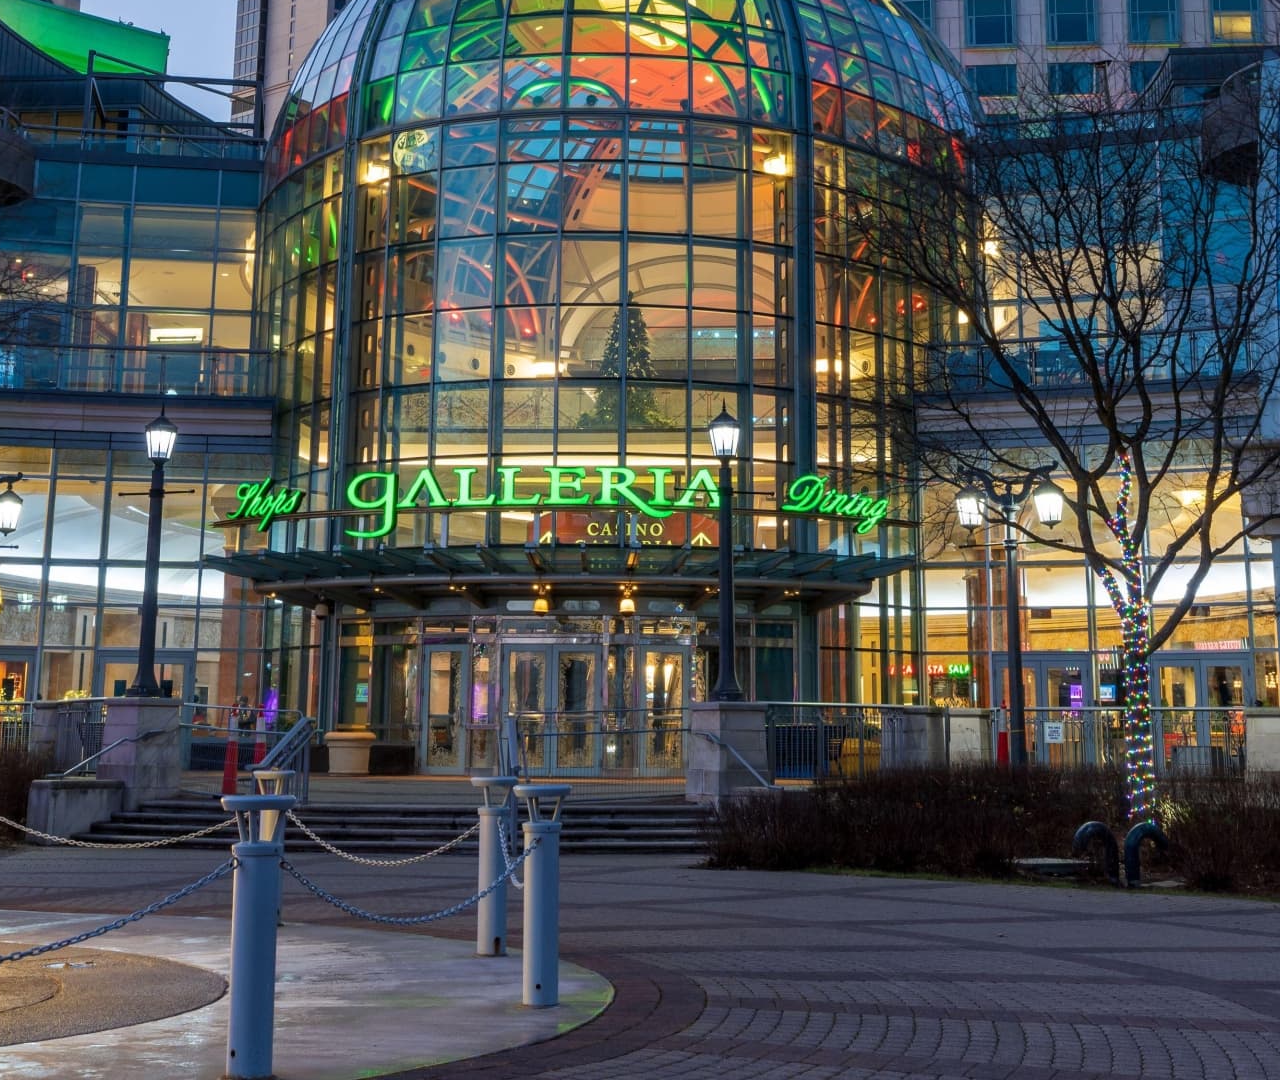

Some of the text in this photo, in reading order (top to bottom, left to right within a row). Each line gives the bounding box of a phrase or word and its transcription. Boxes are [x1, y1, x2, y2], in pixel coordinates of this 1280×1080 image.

[227, 476, 304, 532] Shops
[587, 522, 663, 537] CAINO
[781, 474, 889, 534] Dining
